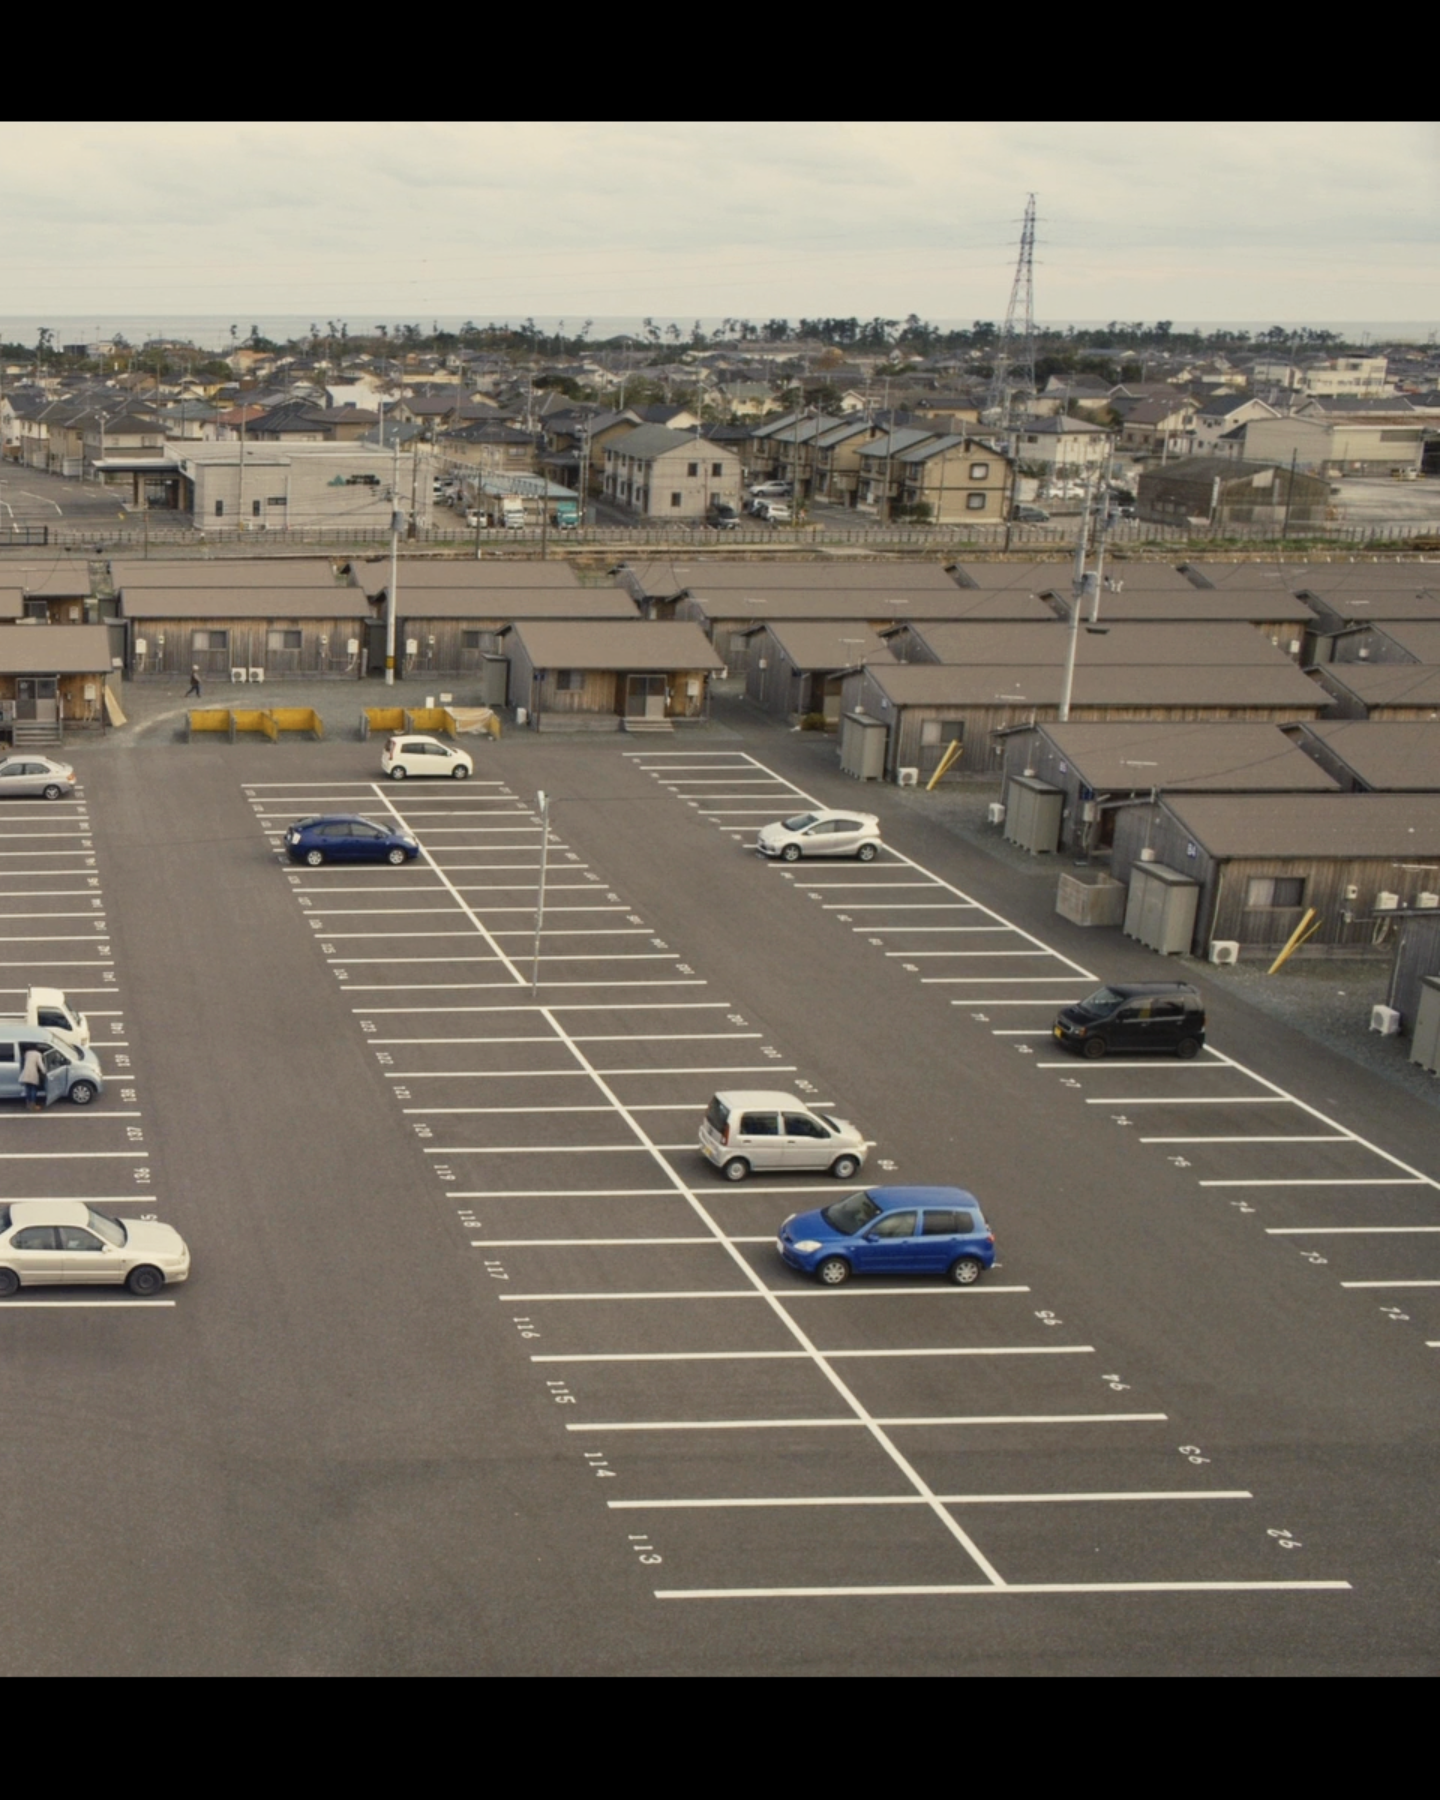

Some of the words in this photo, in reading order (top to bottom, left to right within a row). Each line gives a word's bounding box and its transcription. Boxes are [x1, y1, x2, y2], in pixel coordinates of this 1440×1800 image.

[114, 1053, 132, 1068] 139
[119, 1087, 138, 1103] 138
[392, 1085, 412, 1100] 121
[125, 1125, 144, 1142] 137
[411, 1122, 434, 1138] 120
[133, 1166, 151, 1184] 136
[433, 1164, 457, 1181] 119
[456, 1209, 483, 1229] 118
[1299, 1250, 1329, 1265] 73
[483, 1260, 510, 1281] 117
[1033, 1309, 1064, 1327] 95
[1378, 1306, 1411, 1321] 72
[512, 1316, 542, 1340] 116
[1100, 1373, 1132, 1392] 94
[545, 1380, 577, 1405] 115
[1177, 1444, 1212, 1465] 93
[582, 1451, 618, 1478] 114
[1265, 1527, 1303, 1550] 92
[627, 1533, 664, 1566] 113
